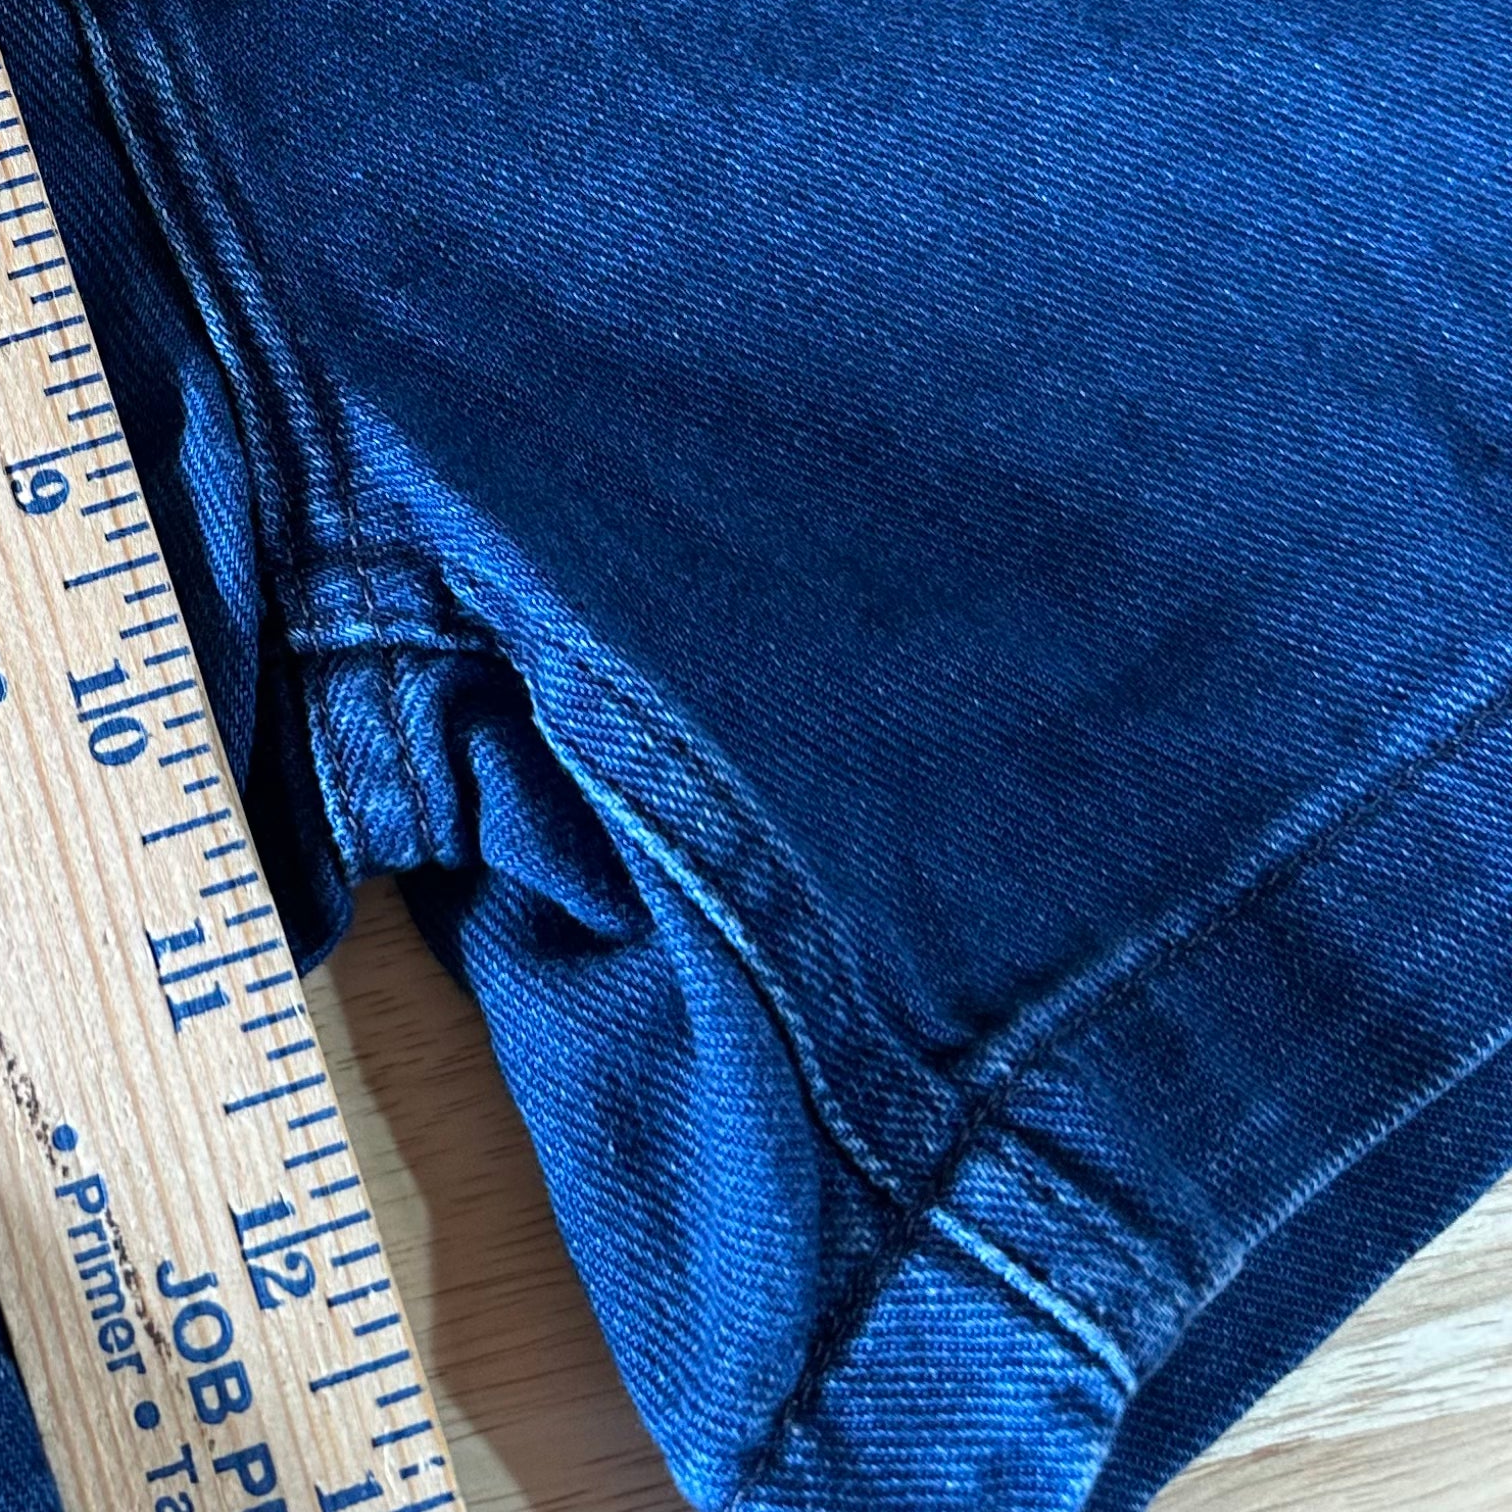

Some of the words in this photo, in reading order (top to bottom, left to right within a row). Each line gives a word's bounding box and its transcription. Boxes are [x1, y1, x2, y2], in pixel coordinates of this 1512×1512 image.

[10, 468, 71, 516] 9
[67, 658, 149, 767] 10
[146, 917, 230, 1033] 11
[229, 1191, 317, 1311] 12
[55, 1173, 147, 1376] Primer
[156, 1259, 254, 1425] JOB
